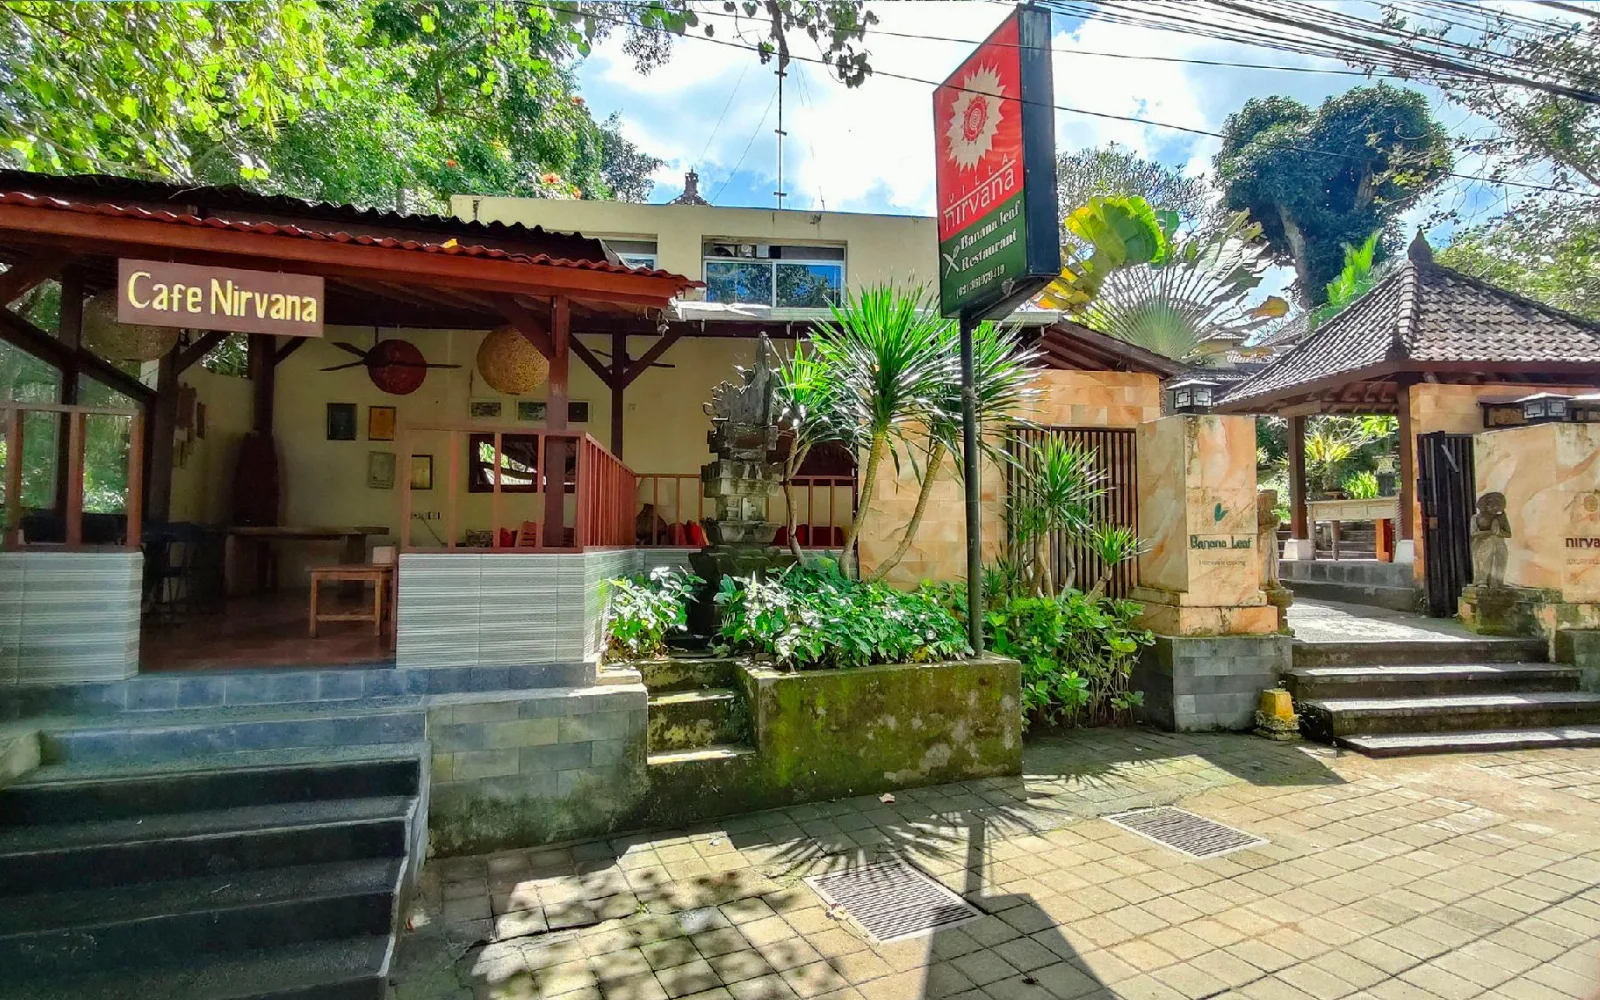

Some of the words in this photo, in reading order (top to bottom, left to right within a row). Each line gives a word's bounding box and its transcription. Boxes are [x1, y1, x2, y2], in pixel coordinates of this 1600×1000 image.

[944, 167, 1015, 232] nirvana
[960, 220, 998, 250] Banana
[1000, 200, 1020, 226] leaf
[961, 228, 1017, 271] Restaurant
[128, 272, 202, 313] Cafe
[211, 278, 317, 322] Nirvana
[1190, 535, 1227, 549] Banana
[1231, 535, 1252, 549] Leaf
